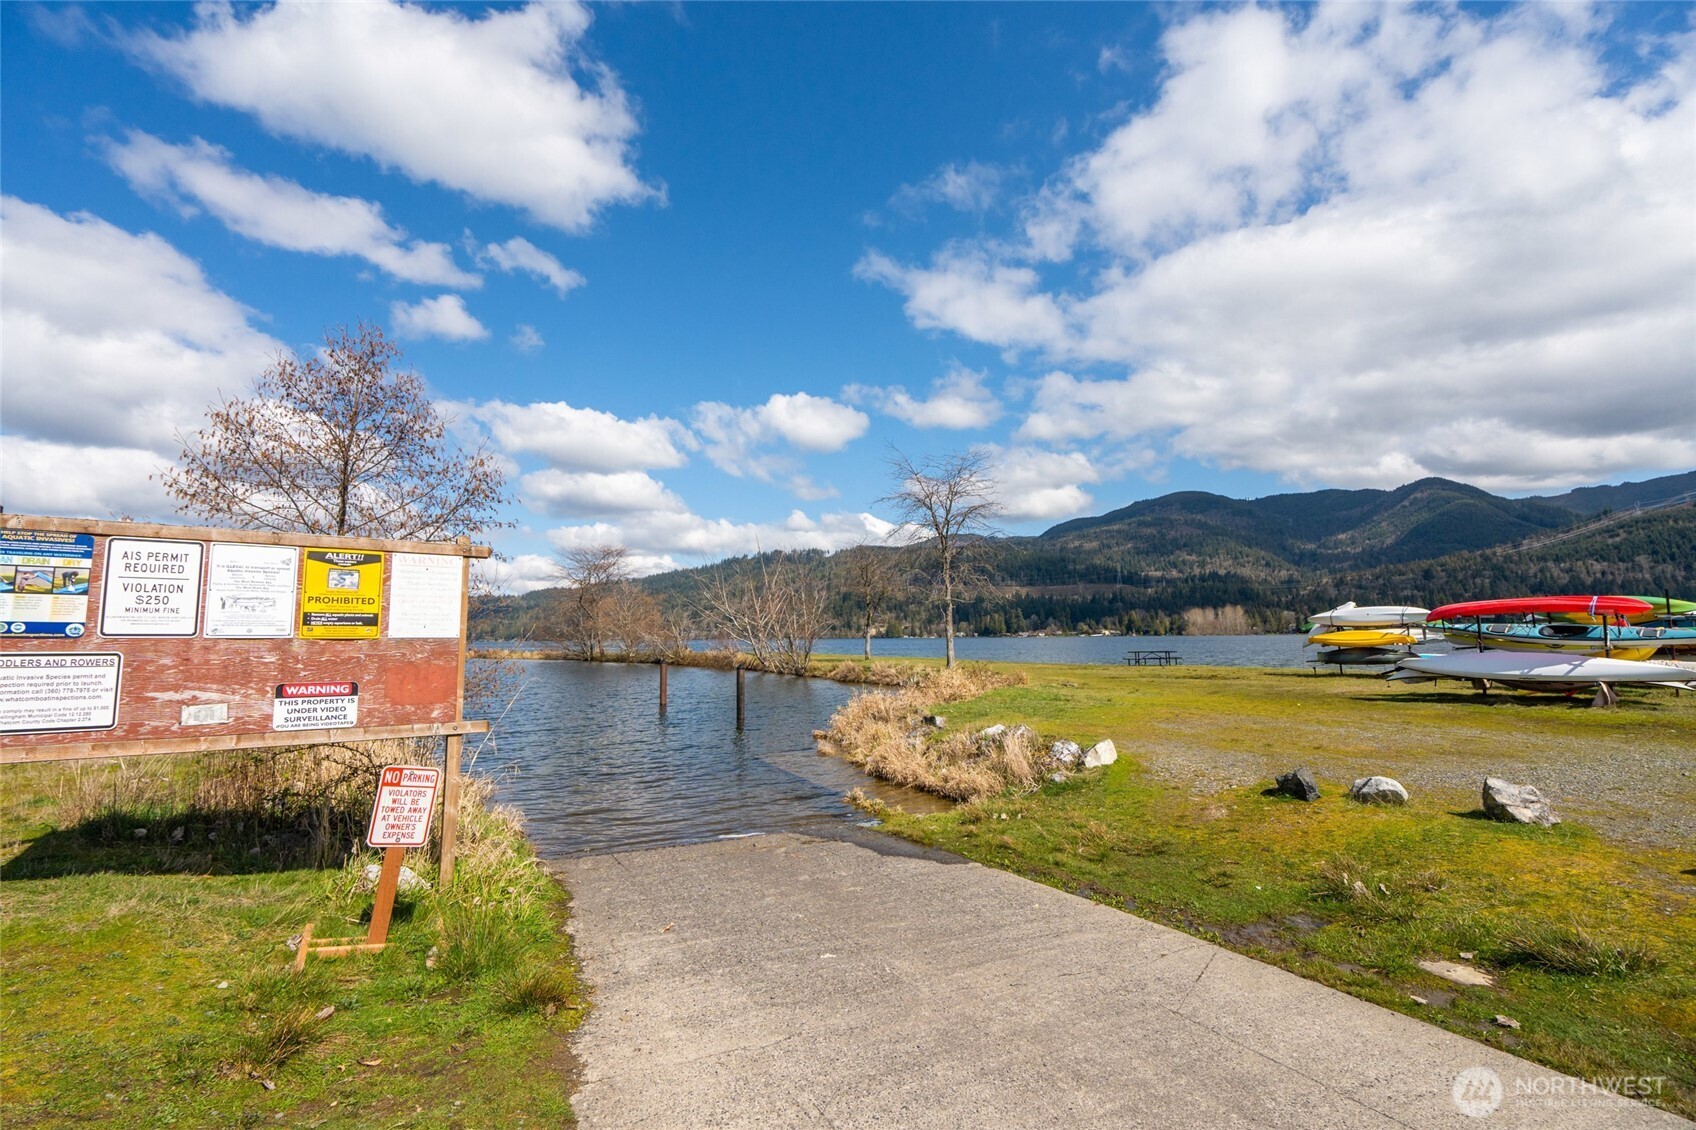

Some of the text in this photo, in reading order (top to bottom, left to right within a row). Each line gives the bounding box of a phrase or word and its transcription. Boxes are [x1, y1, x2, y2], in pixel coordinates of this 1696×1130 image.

[122, 551, 190, 562] AIS PERMIT
[325, 552, 364, 560] ALERT!!
[22, 557, 50, 565] DRAIN
[124, 562, 184, 574] REQUIRED
[122, 582, 184, 594] VIOLATION
[134, 595, 170, 605] $250
[308, 596, 376, 604] PROHIBITED
[45, 658, 67, 666] AND
[286, 685, 350, 694] WARNING
[301, 698, 346, 706] PROPERTY
[284, 714, 348, 723] SURVEILLANCE
[384, 771, 436, 784] NO PARKING
[388, 789, 427, 797] VIOLATORS
